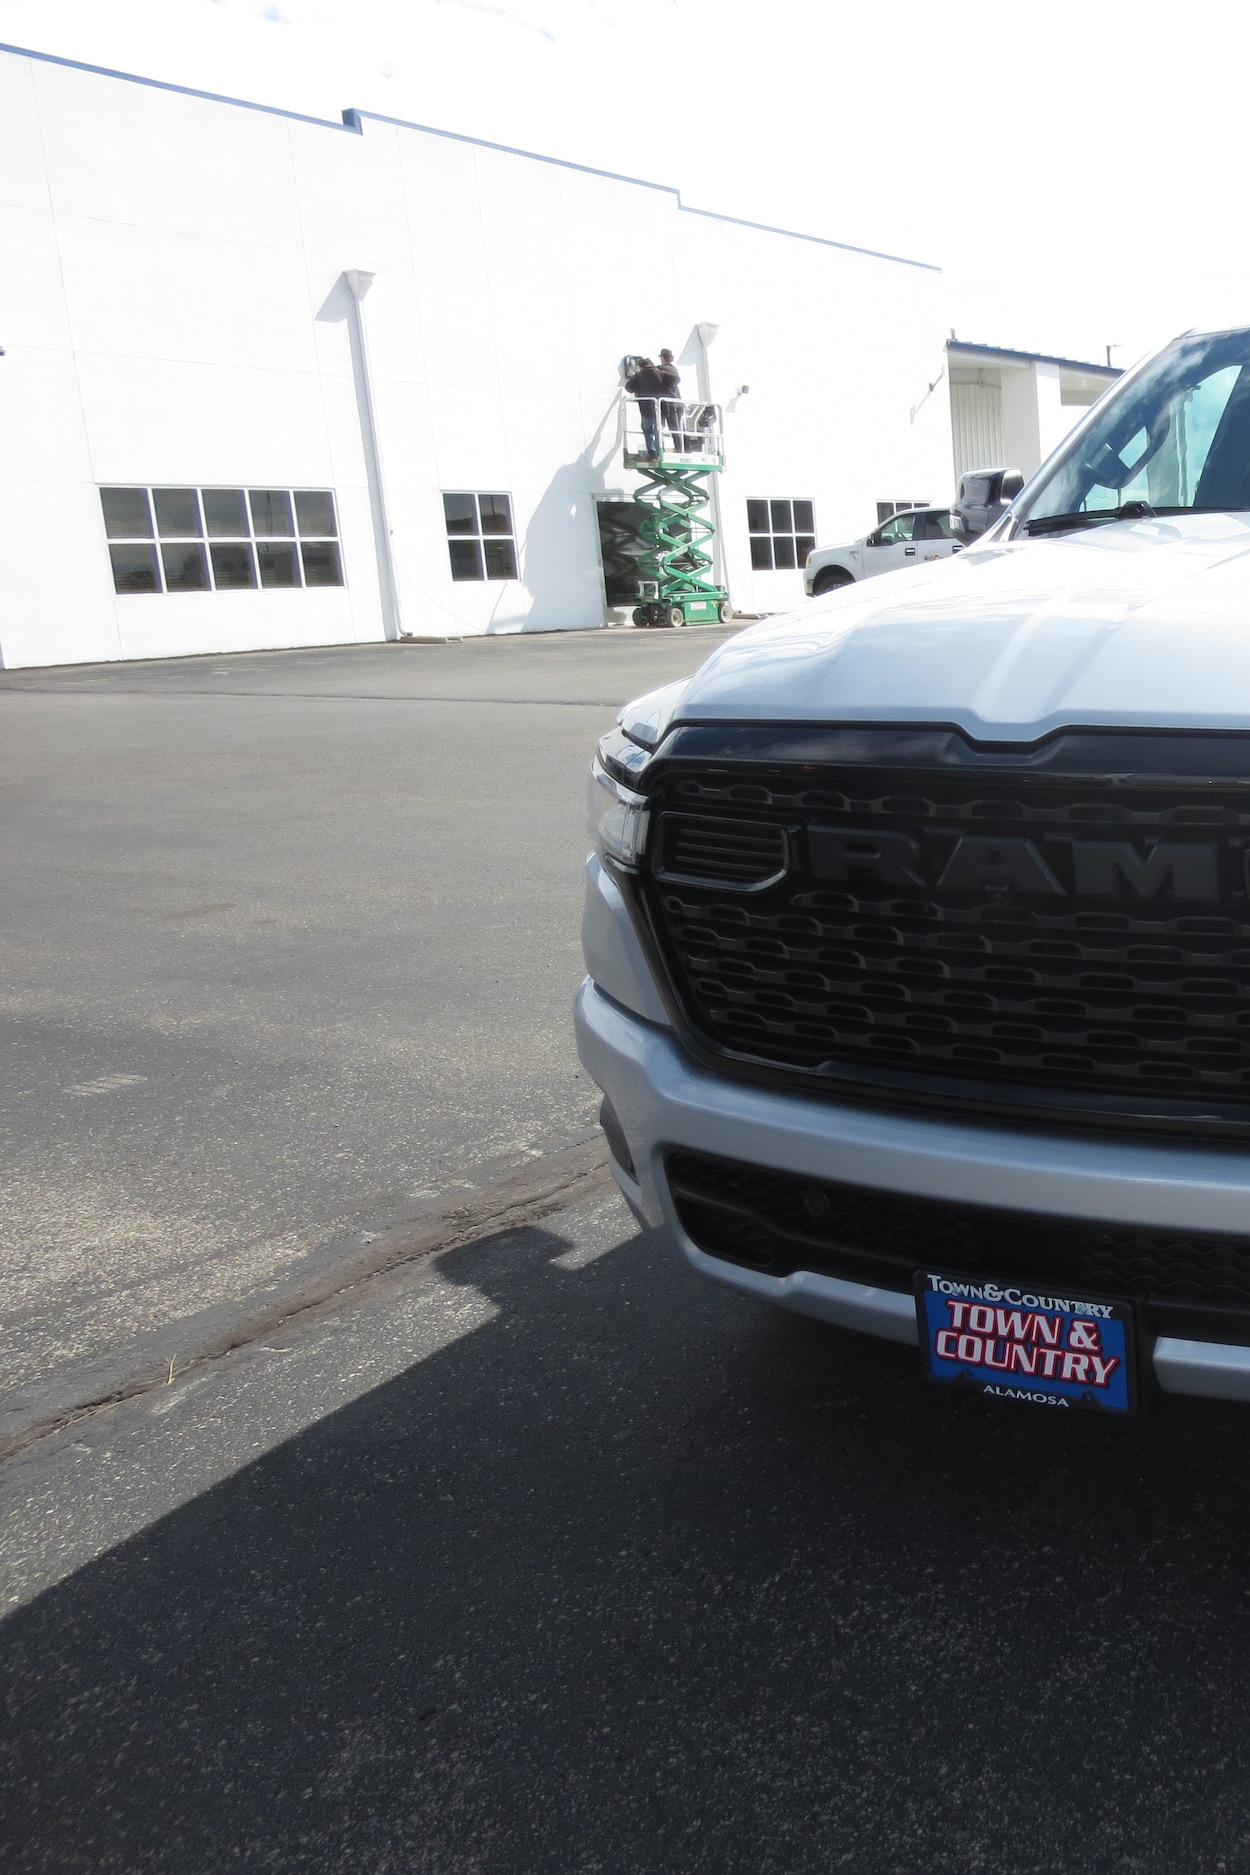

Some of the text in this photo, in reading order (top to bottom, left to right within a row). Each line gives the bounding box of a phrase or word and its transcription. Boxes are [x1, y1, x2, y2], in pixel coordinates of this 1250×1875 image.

[807, 824, 1218, 900] RAM
[947, 1300, 1100, 1351] TOWN &
[936, 1329, 1118, 1386] COUNTRY
[983, 1384, 1070, 1408] ALAMOSA
